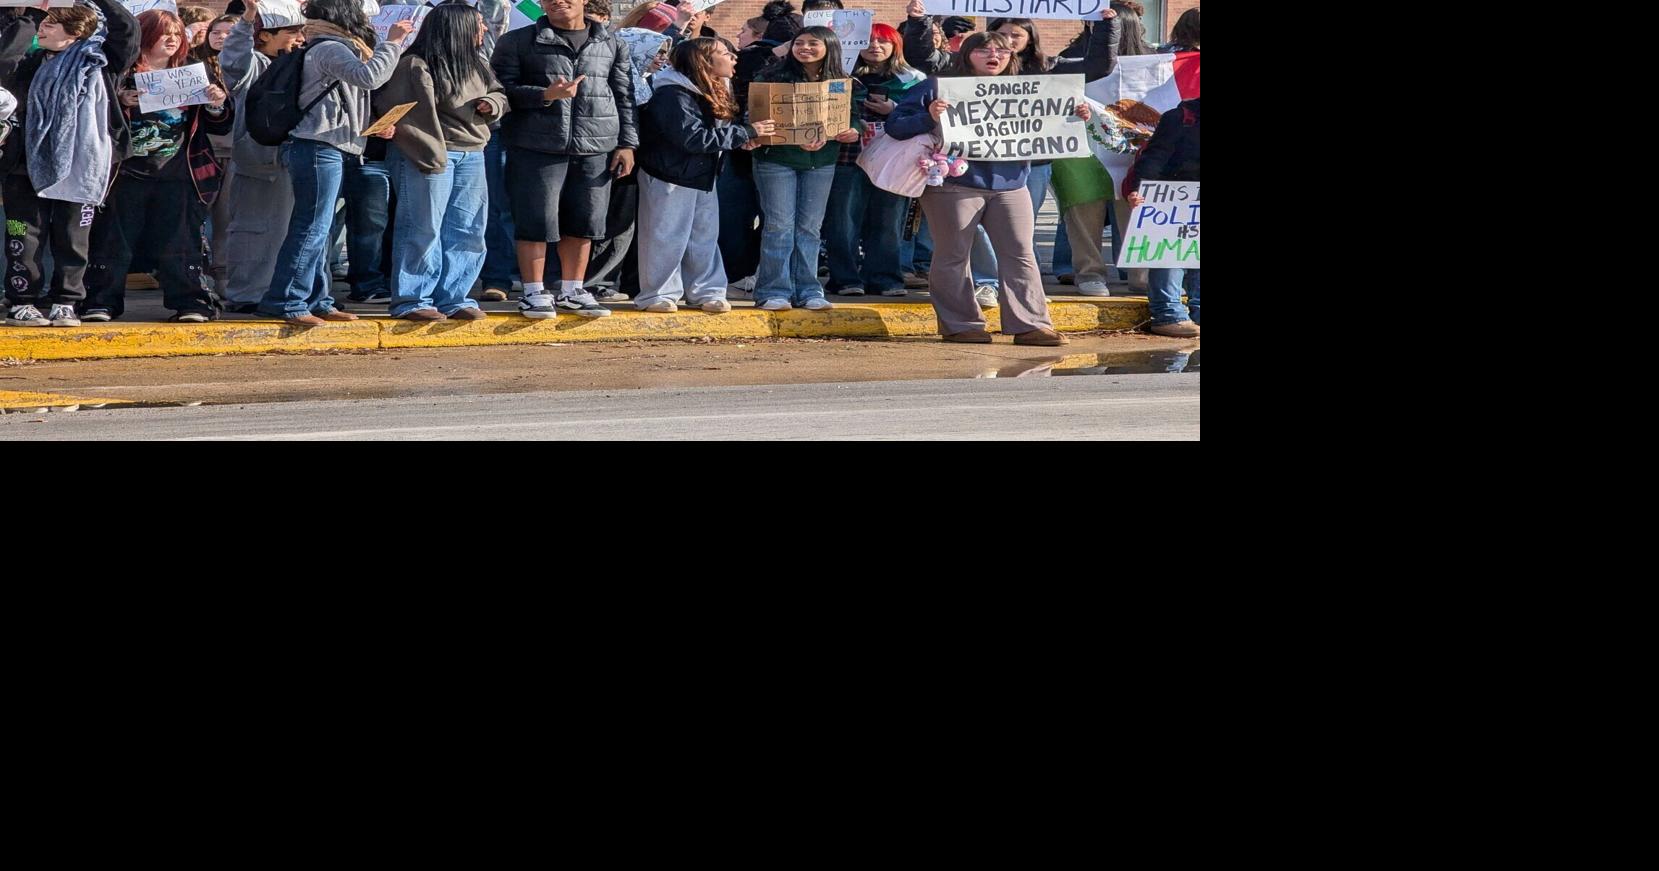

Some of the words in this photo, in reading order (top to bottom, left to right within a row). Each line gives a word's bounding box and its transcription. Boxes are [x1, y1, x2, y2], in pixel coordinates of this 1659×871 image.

[168, 68, 192, 79] WAS
[975, 81, 1041, 97] SANGRE
[946, 96, 1076, 127] MEXICANA
[947, 136, 1079, 158] MEXICANO
[1126, 235, 1200, 263] HUMA
